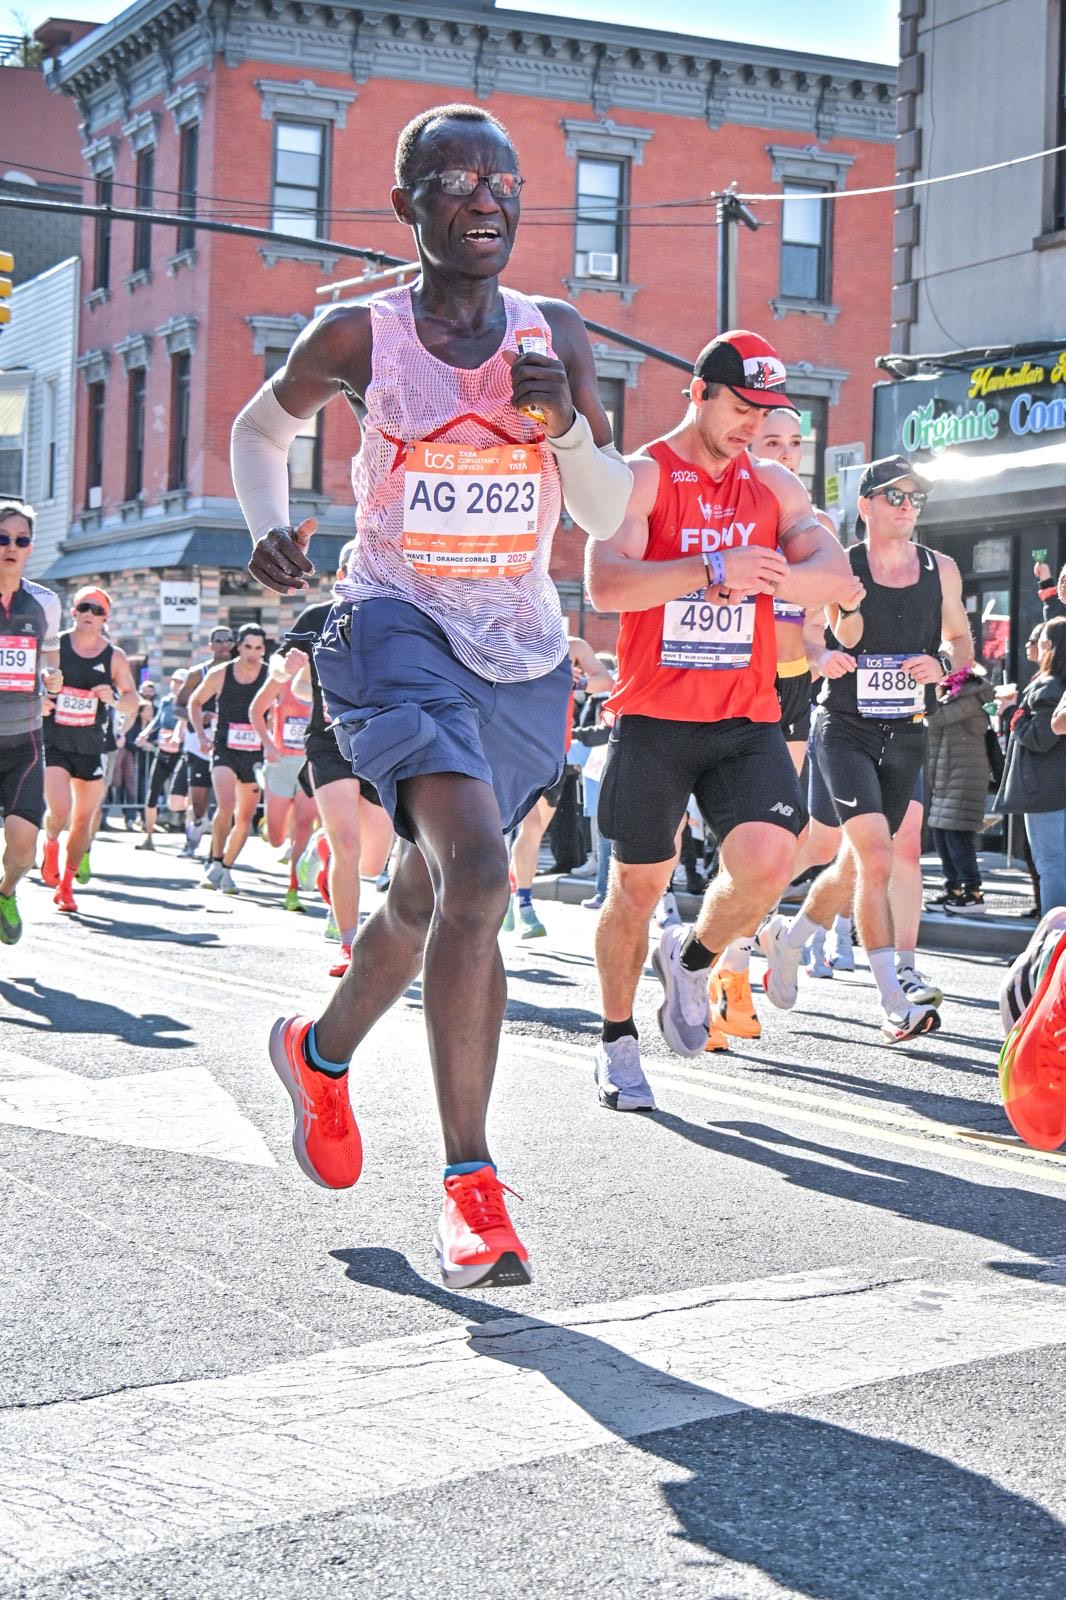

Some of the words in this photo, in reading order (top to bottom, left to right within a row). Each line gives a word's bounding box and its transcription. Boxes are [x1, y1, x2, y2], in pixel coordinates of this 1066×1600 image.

[902, 398, 999, 456] Organic
[1009, 393, 1066, 436] Con
[424, 448, 455, 470] tcs
[671, 470, 698, 484] 2025
[409, 480, 456, 513] AG
[466, 481, 535, 513] 2623
[680, 522, 757, 553] FDNY
[405, 552, 425, 560] WAVE
[425, 553, 431, 562] 1
[490, 555, 497, 563] B
[507, 553, 527, 563] 2025
[680, 604, 743, 633] 4901
[0, 650, 26, 667] 159
[866, 657, 882, 668] tcs
[867, 671, 917, 691] 4888
